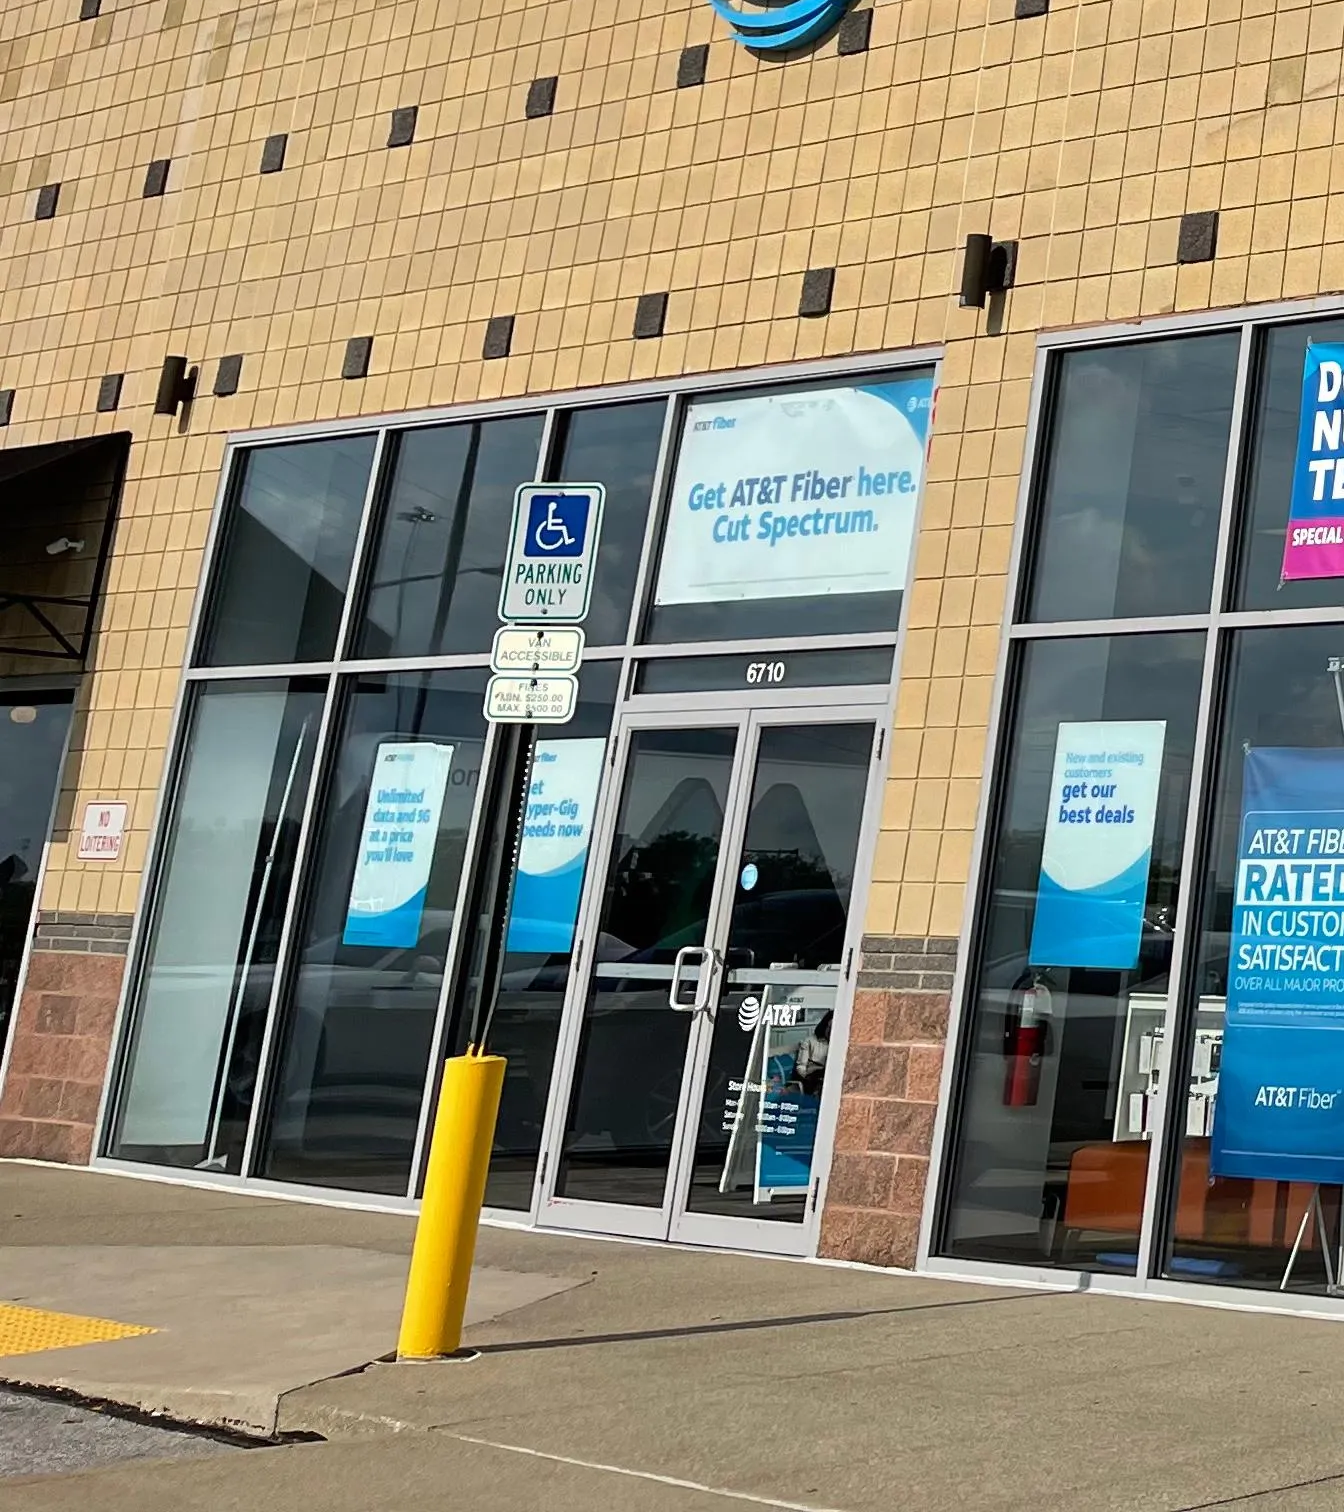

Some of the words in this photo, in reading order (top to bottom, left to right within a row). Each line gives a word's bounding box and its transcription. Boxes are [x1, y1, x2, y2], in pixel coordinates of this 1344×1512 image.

[688, 483, 727, 511] Get
[729, 475, 787, 508] AT&T
[791, 470, 852, 503] Fiber
[856, 466, 916, 497] here.
[712, 514, 751, 543] Cut
[757, 508, 878, 546] Spectrum.
[1292, 527, 1344, 546] SPECIAL
[515, 563, 583, 585] PARKING
[524, 588, 567, 606] ONLY
[528, 638, 551, 648] VAN
[500, 651, 574, 662] ACCESSIBLE
[747, 662, 785, 683] 6710
[1066, 753, 1086, 763] New
[1088, 751, 1106, 763] and
[1107, 751, 1144, 766] existing
[1064, 769, 1112, 778] customers
[377, 788, 425, 803] Unlimited
[531, 780, 544, 795] et
[1062, 782, 1088, 803] get
[1091, 784, 1117, 798] our
[373, 808, 394, 822] data
[396, 808, 416, 823] and
[527, 798, 578, 820] yper-Gig
[1059, 805, 1092, 823] best
[1095, 804, 1135, 823] deals
[98, 811, 111, 827] NO
[369, 830, 381, 842] at
[388, 828, 414, 845] price
[558, 824, 583, 838] now
[80, 835, 120, 852] LOITERING
[1248, 828, 1305, 854] AT&T
[393, 848, 414, 862] love
[1242, 910, 1263, 937] IN
[1235, 976, 1263, 991] OVER
[1264, 977, 1282, 991] ALL
[1284, 978, 1321, 992] MAJOR
[762, 1004, 801, 1026] AT&T
[1254, 1085, 1297, 1109] AT&T
[1298, 1086, 1338, 1110] Fiber
